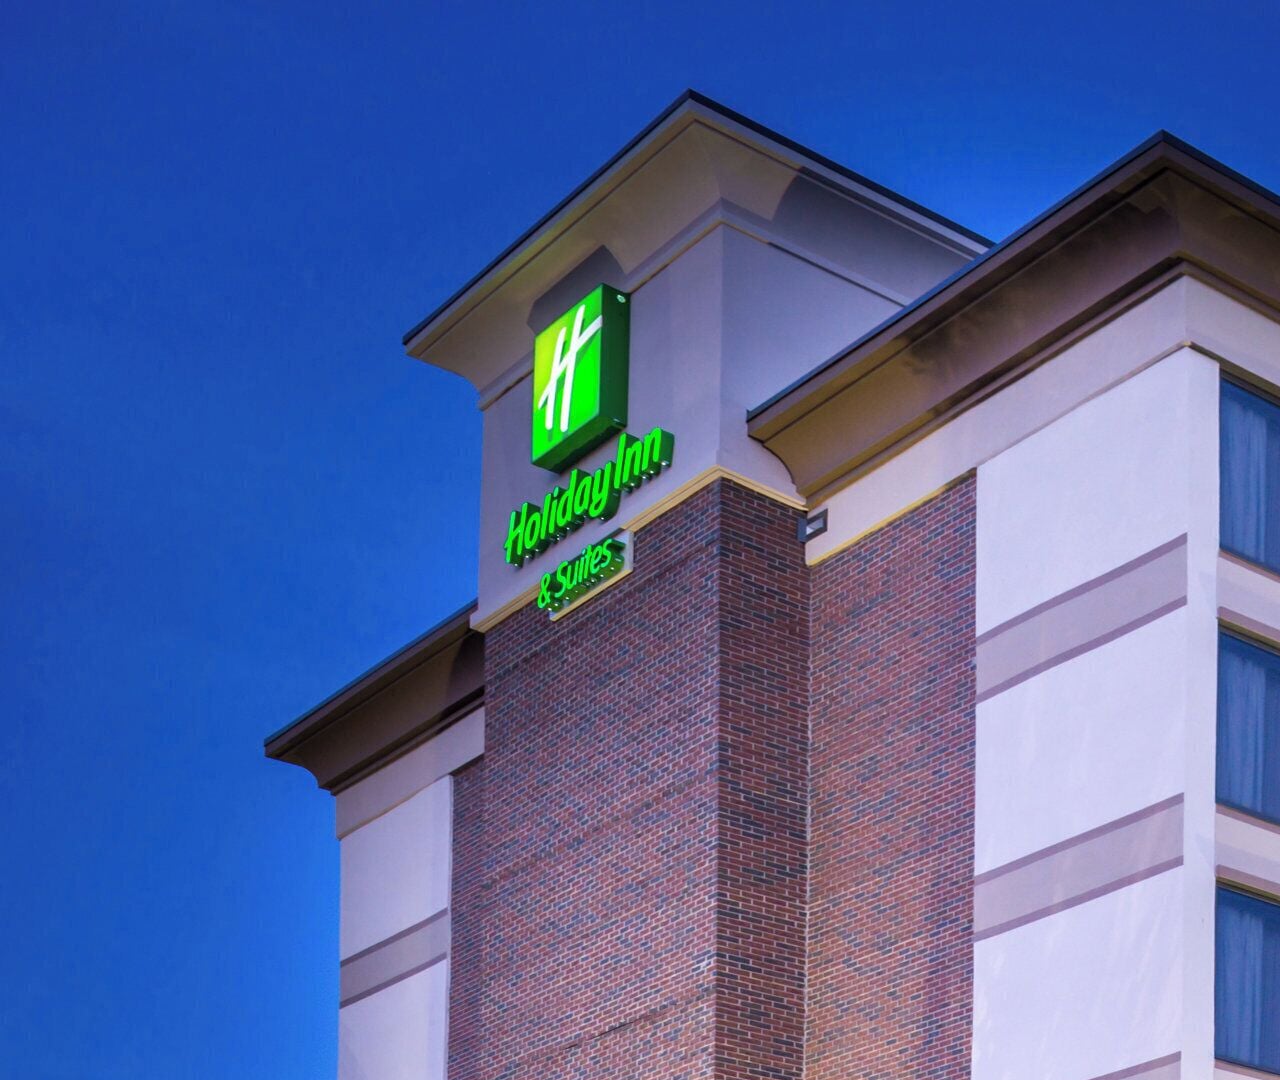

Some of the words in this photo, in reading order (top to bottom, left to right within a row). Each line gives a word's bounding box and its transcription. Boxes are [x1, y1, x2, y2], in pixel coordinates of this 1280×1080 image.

[537, 304, 602, 432] H
[504, 461, 612, 564] Holiday
[614, 427, 662, 489] Inn
[538, 573, 551, 609] &
[555, 538, 613, 598] Suites
